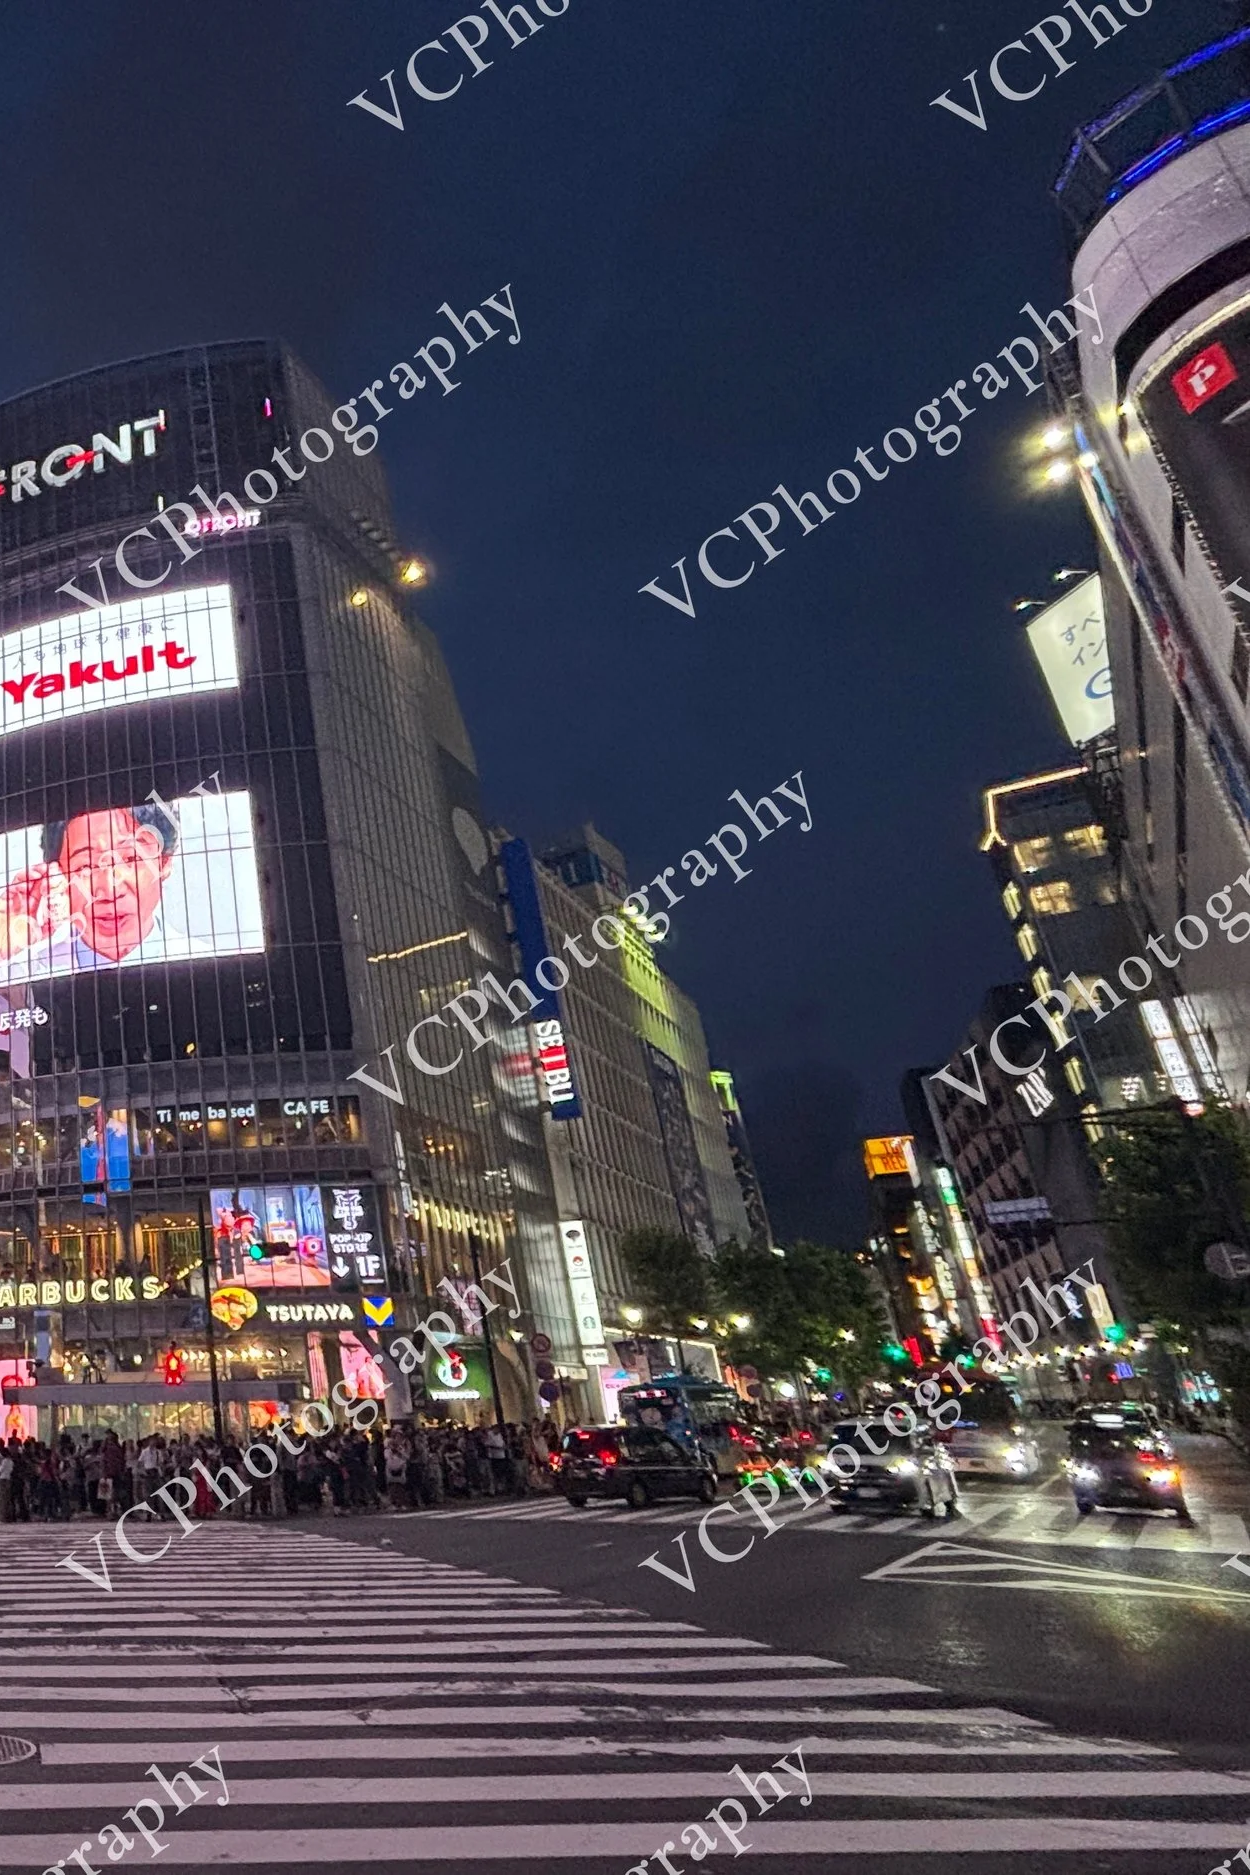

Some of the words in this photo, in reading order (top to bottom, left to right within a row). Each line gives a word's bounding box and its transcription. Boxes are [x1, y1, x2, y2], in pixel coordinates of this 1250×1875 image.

[12, 617, 176, 671] 人も地球も健康に
[0, 641, 197, 705] Yakult
[356, 1254, 381, 1277] 1F
[266, 1303, 354, 1323] TSUTAYA
